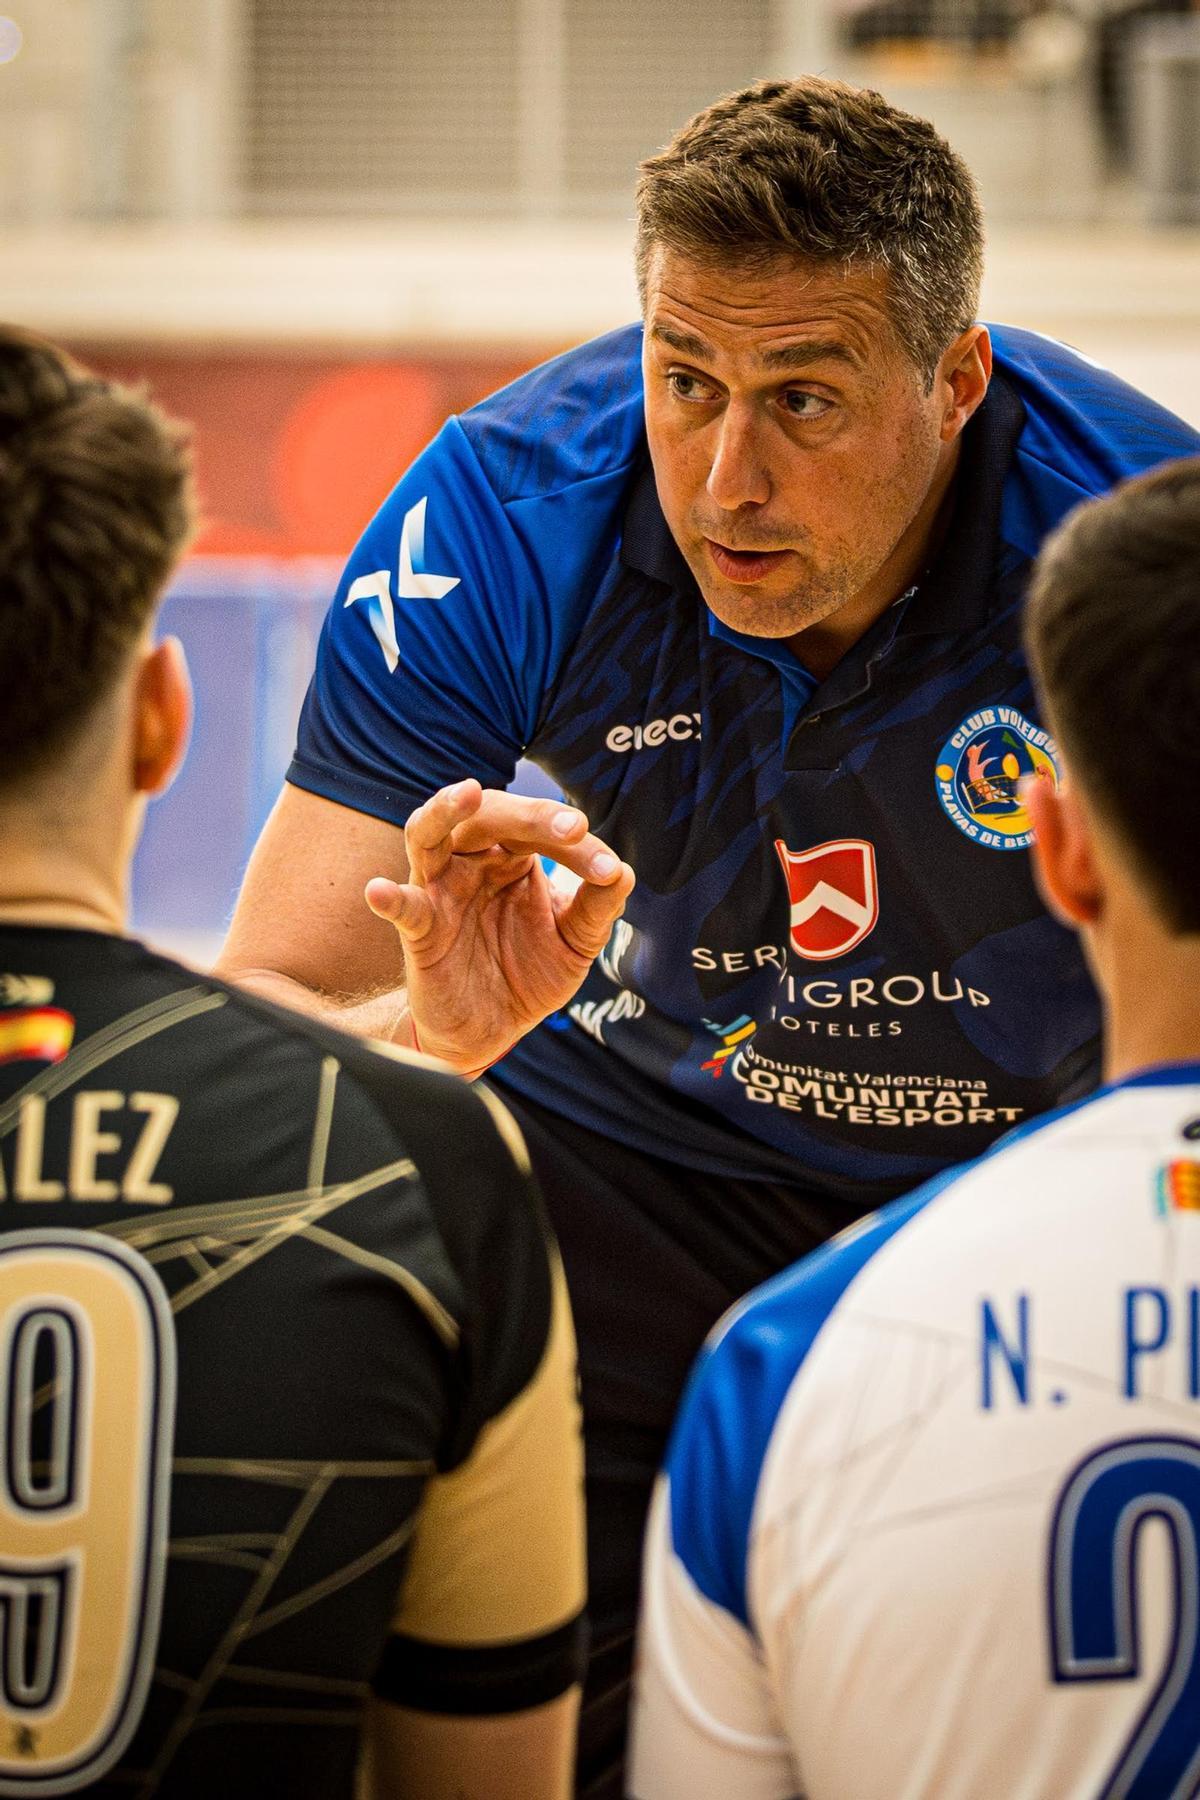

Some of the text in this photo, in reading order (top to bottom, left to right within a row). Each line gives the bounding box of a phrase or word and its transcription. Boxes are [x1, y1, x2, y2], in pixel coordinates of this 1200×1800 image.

[950, 707, 1060, 761] CLUB VOLEIBO
[939, 782, 979, 837] PLAYAS
[979, 831, 1002, 848] DE
[771, 1005, 902, 1036] OTELES
[731, 1051, 988, 1108] COMUNITAT
[745, 1085, 802, 1112] DE
[853, 1072, 988, 1090] Valenciana
[0, 1090, 181, 1205] LEZ
[980, 1294, 1066, 1411] N.
